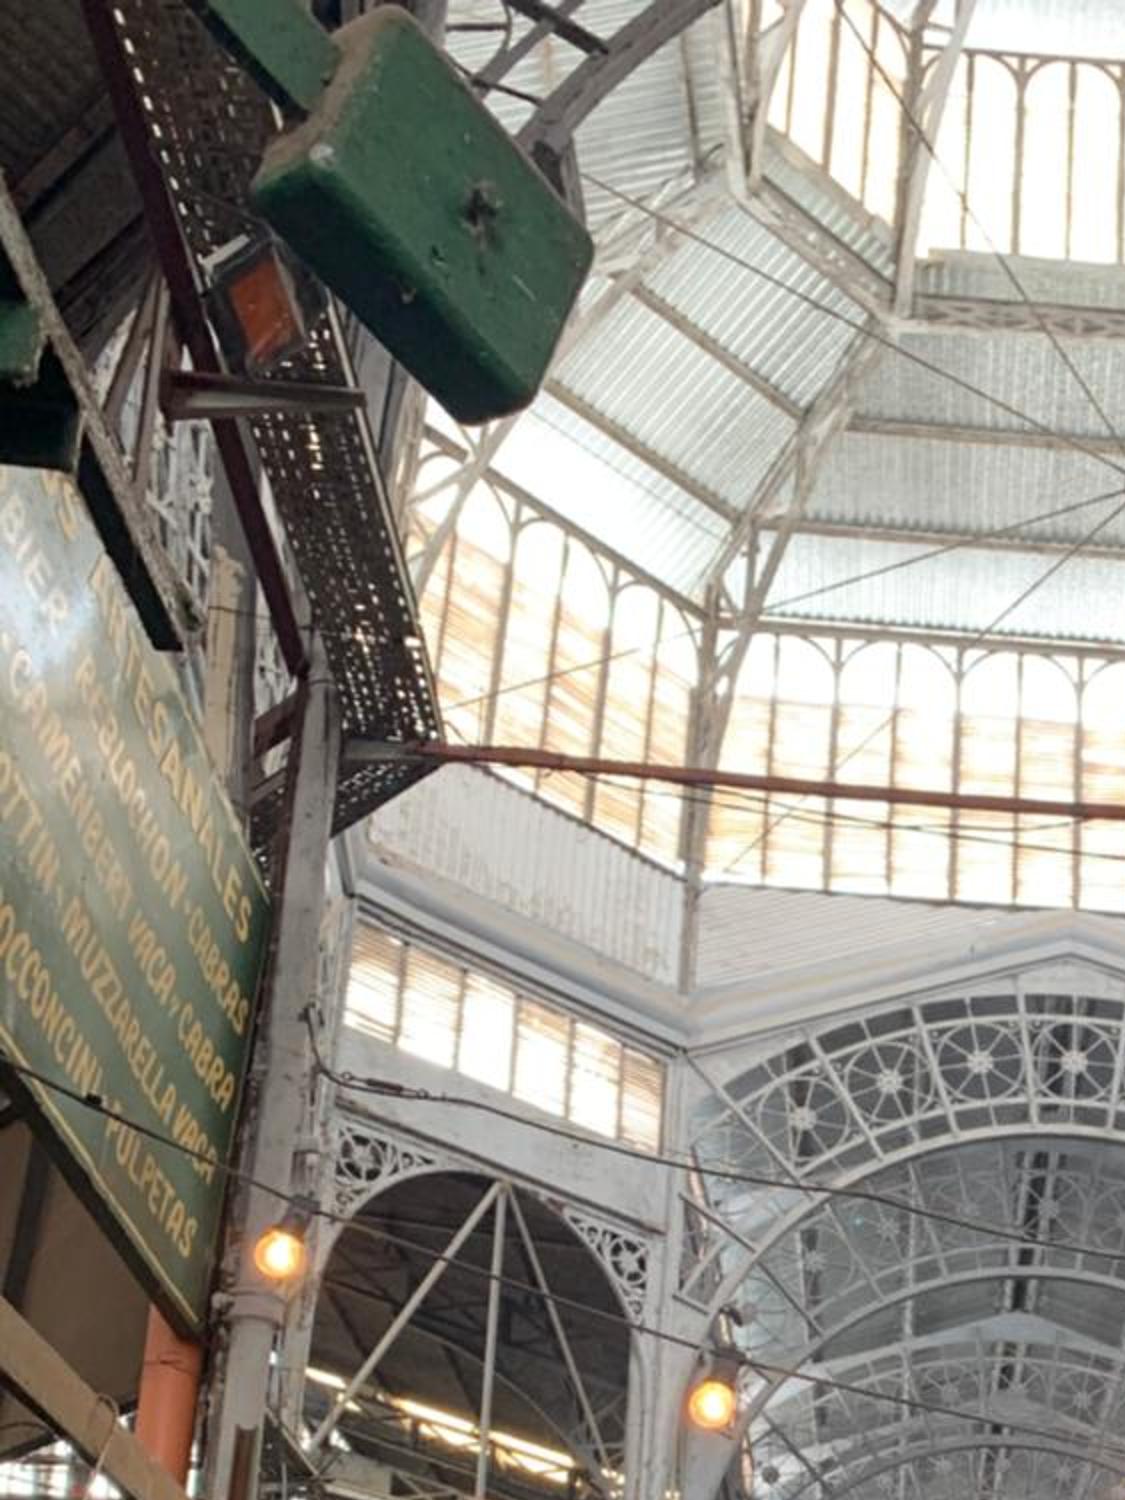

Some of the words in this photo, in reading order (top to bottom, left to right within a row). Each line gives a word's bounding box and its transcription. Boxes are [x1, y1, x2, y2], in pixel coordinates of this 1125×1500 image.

[8, 648, 132, 920] CAMEMBERT
[128, 908, 177, 998] VACA
[178, 1002, 236, 1113] CABRA
[76, 654, 188, 907] REBLOCHON
[187, 904, 250, 1038] CABRAS
[61, 895, 177, 1125] MUZZARELLA
[105, 1098, 199, 1261] PULPETAS
